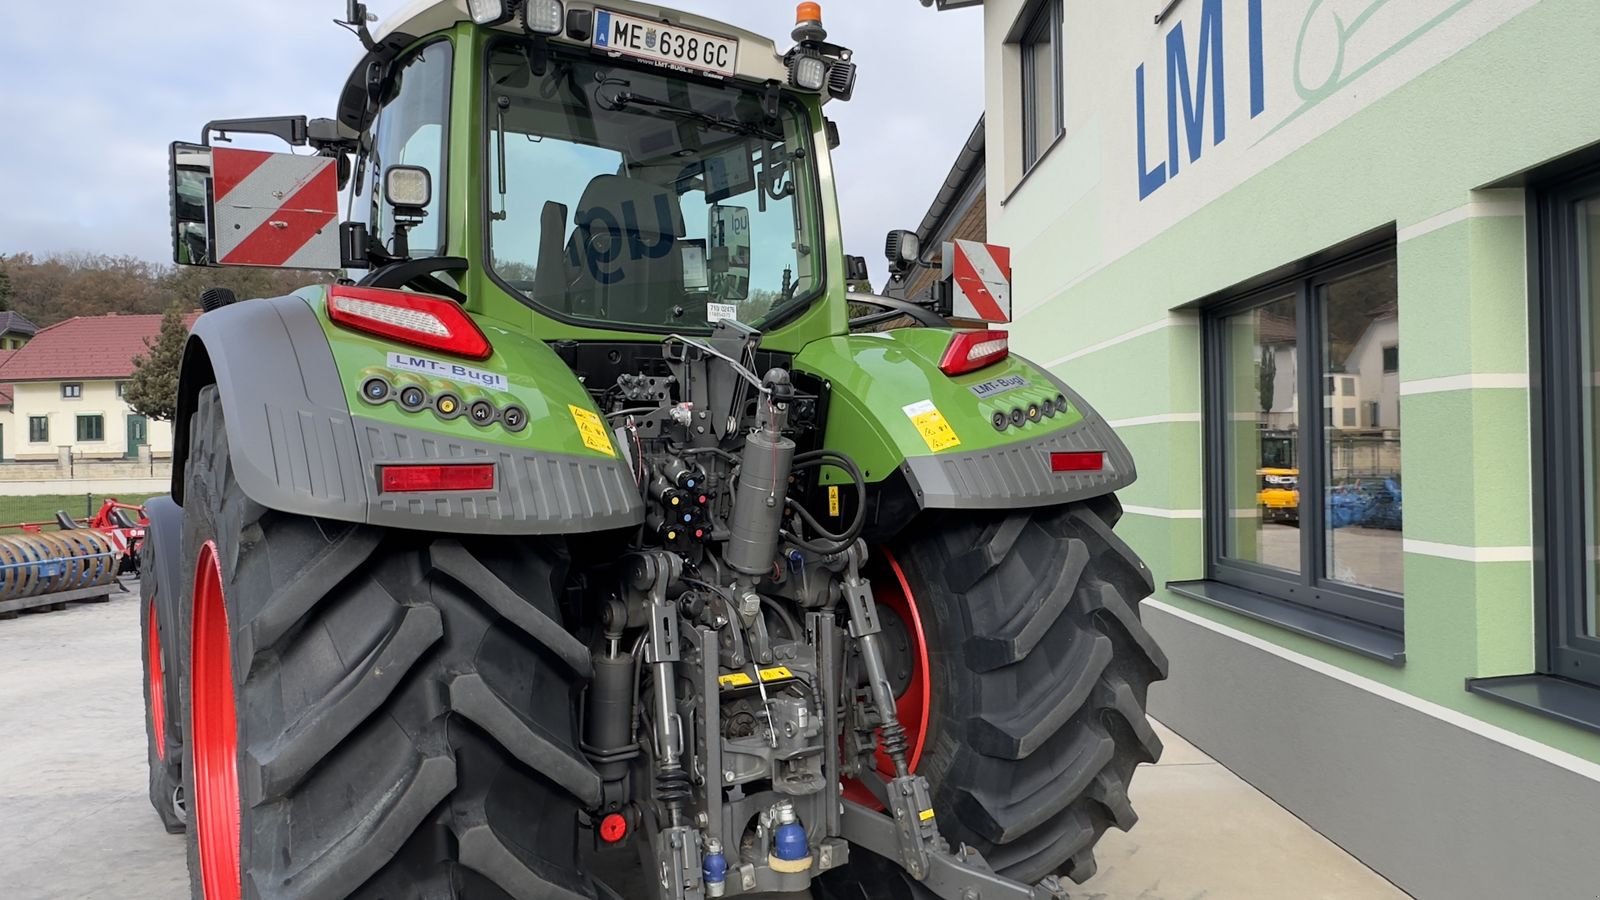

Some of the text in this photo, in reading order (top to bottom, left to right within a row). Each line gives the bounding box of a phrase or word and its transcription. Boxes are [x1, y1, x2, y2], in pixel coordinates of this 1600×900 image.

[598, 33, 606, 42] A
[614, 20, 728, 67] ME 638 GC
